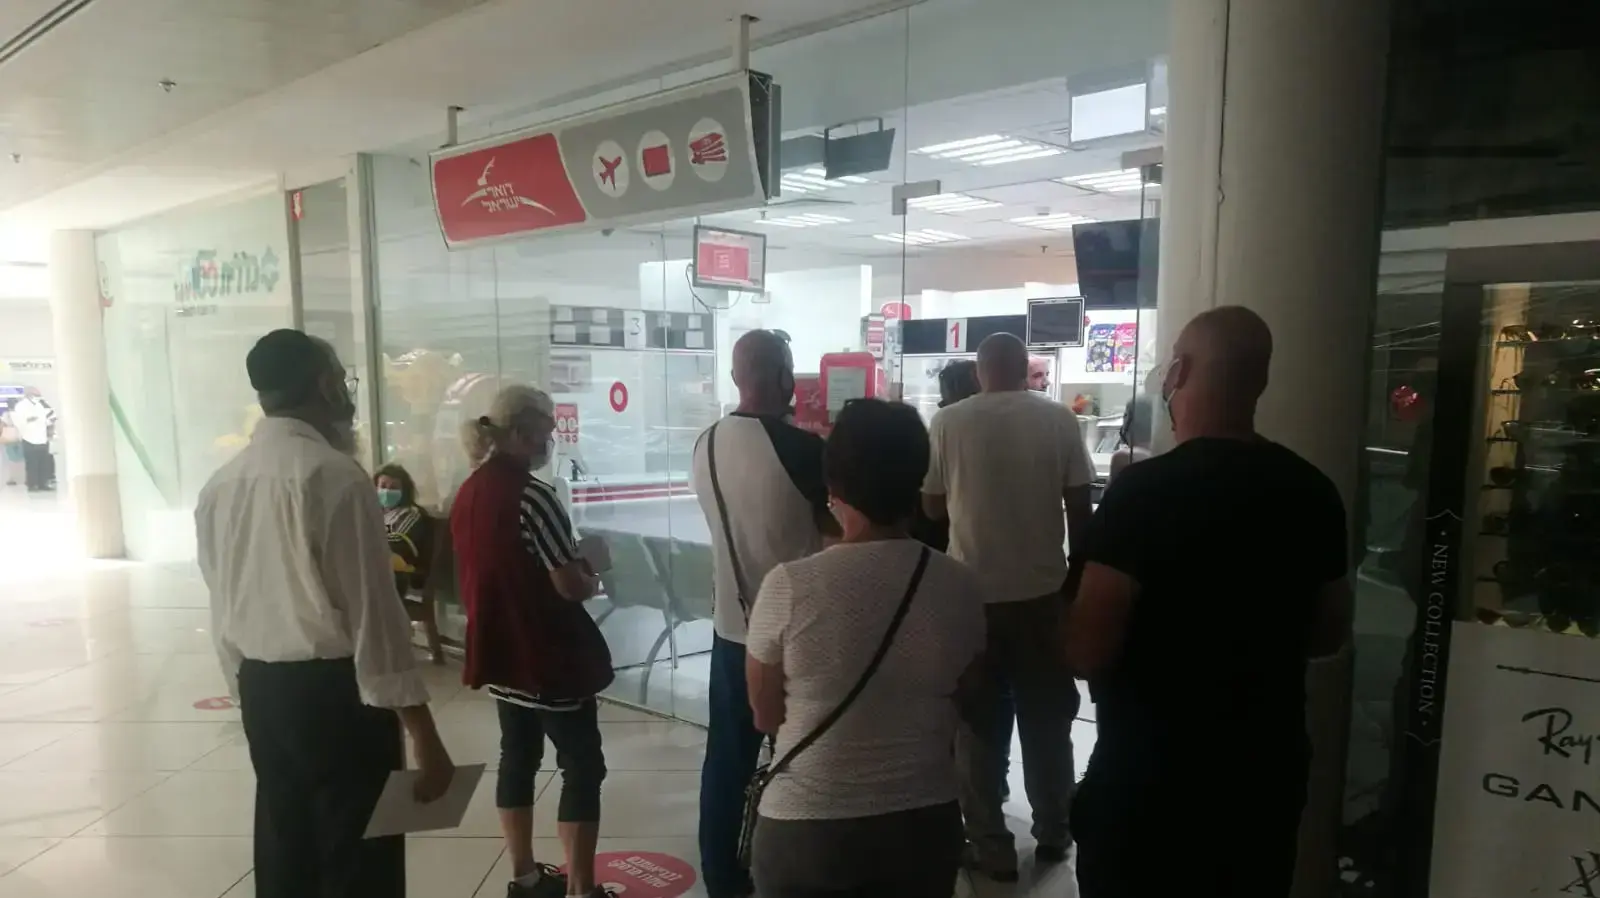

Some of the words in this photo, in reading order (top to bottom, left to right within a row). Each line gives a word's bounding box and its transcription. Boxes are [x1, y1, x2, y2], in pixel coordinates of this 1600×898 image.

[486, 181, 514, 198] דואר
[481, 195, 519, 213] ישראל
[631, 317, 641, 335] 3
[950, 321, 960, 348] 1
[1431, 543, 1449, 585] NEW
[1418, 591, 1444, 717] COLLECTION
